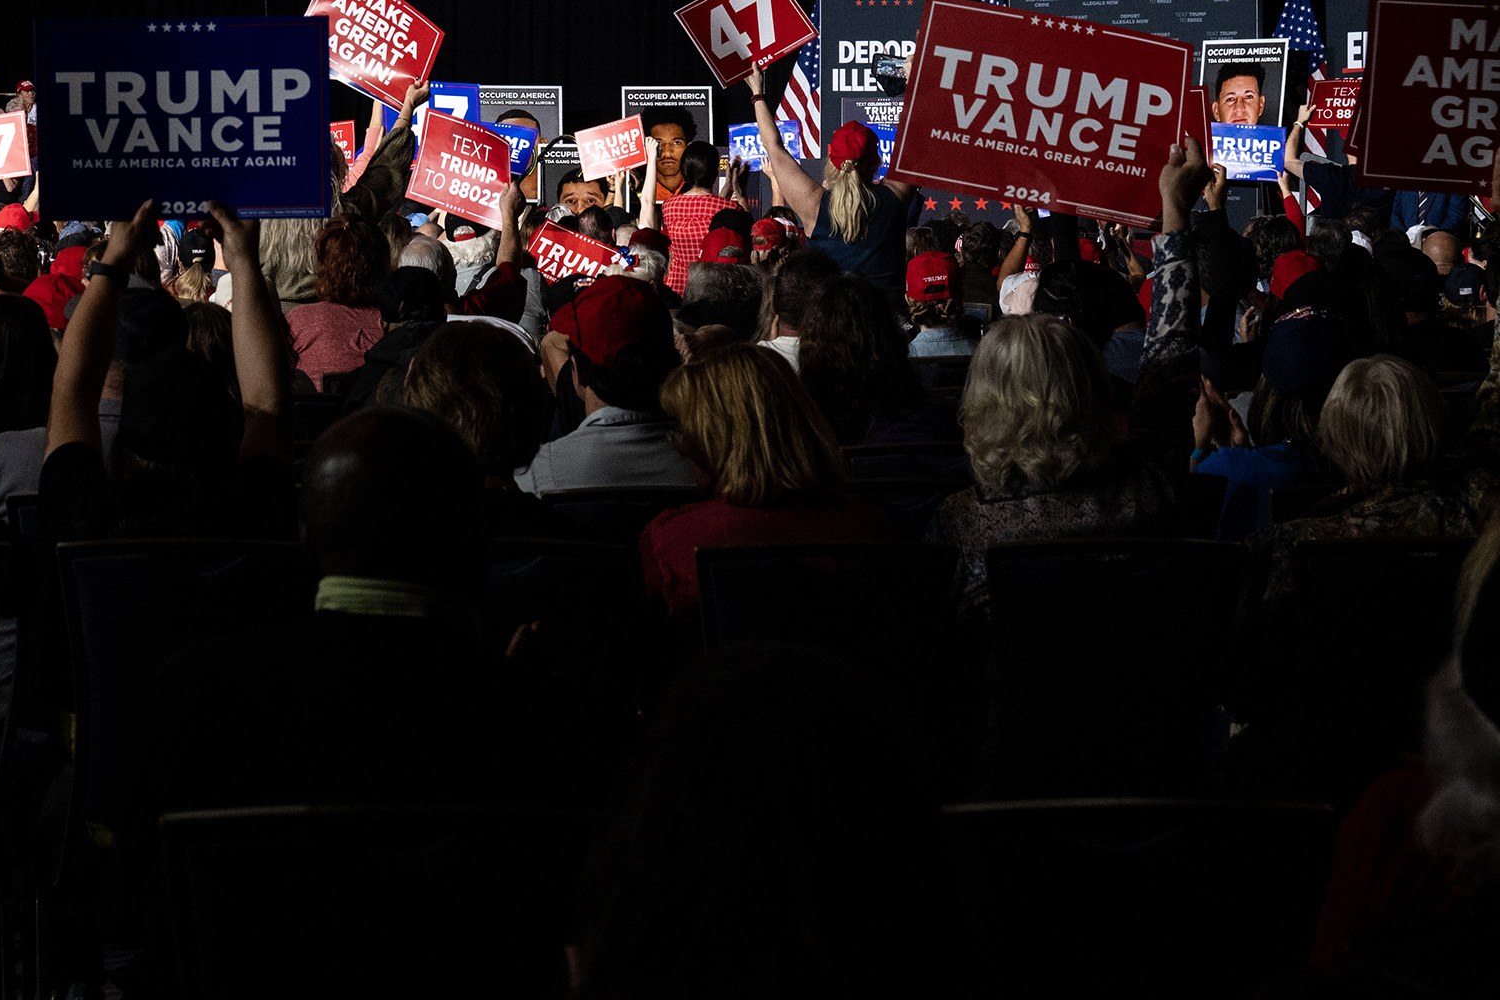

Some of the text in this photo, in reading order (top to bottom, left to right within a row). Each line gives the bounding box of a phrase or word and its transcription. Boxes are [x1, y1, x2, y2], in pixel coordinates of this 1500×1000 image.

[336, 18, 404, 67] GREAT
[1208, 47, 1282, 56] OCCUPIED AMERICA
[329, 34, 396, 86] AGAIN!
[758, 54, 774, 66] 024
[55, 68, 311, 116] TRUMP
[933, 45, 1173, 126] TRUMP
[864, 106, 903, 115] TRUMP
[869, 114, 900, 122] VANCE
[1316, 109, 1332, 119] TO
[85, 115, 282, 154] VANCE
[952, 94, 1142, 161] VANCE
[452, 134, 492, 162] TEXT
[582, 128, 640, 155] TRUMP
[592, 142, 637, 162] VANCE
[1212, 136, 1281, 154] TRUMP
[72, 156, 296, 169] MAKE AMERICA GREAT AGAIN!
[930, 128, 1146, 178] MAKE AMERICA GREAT AGAIN!
[1217, 150, 1272, 164] VANCE
[440, 152, 497, 184] TRUMP
[425, 168, 500, 210] TO 88022
[1004, 184, 1050, 204] 2024
[162, 201, 210, 214] 2024
[537, 256, 573, 278] VAN
